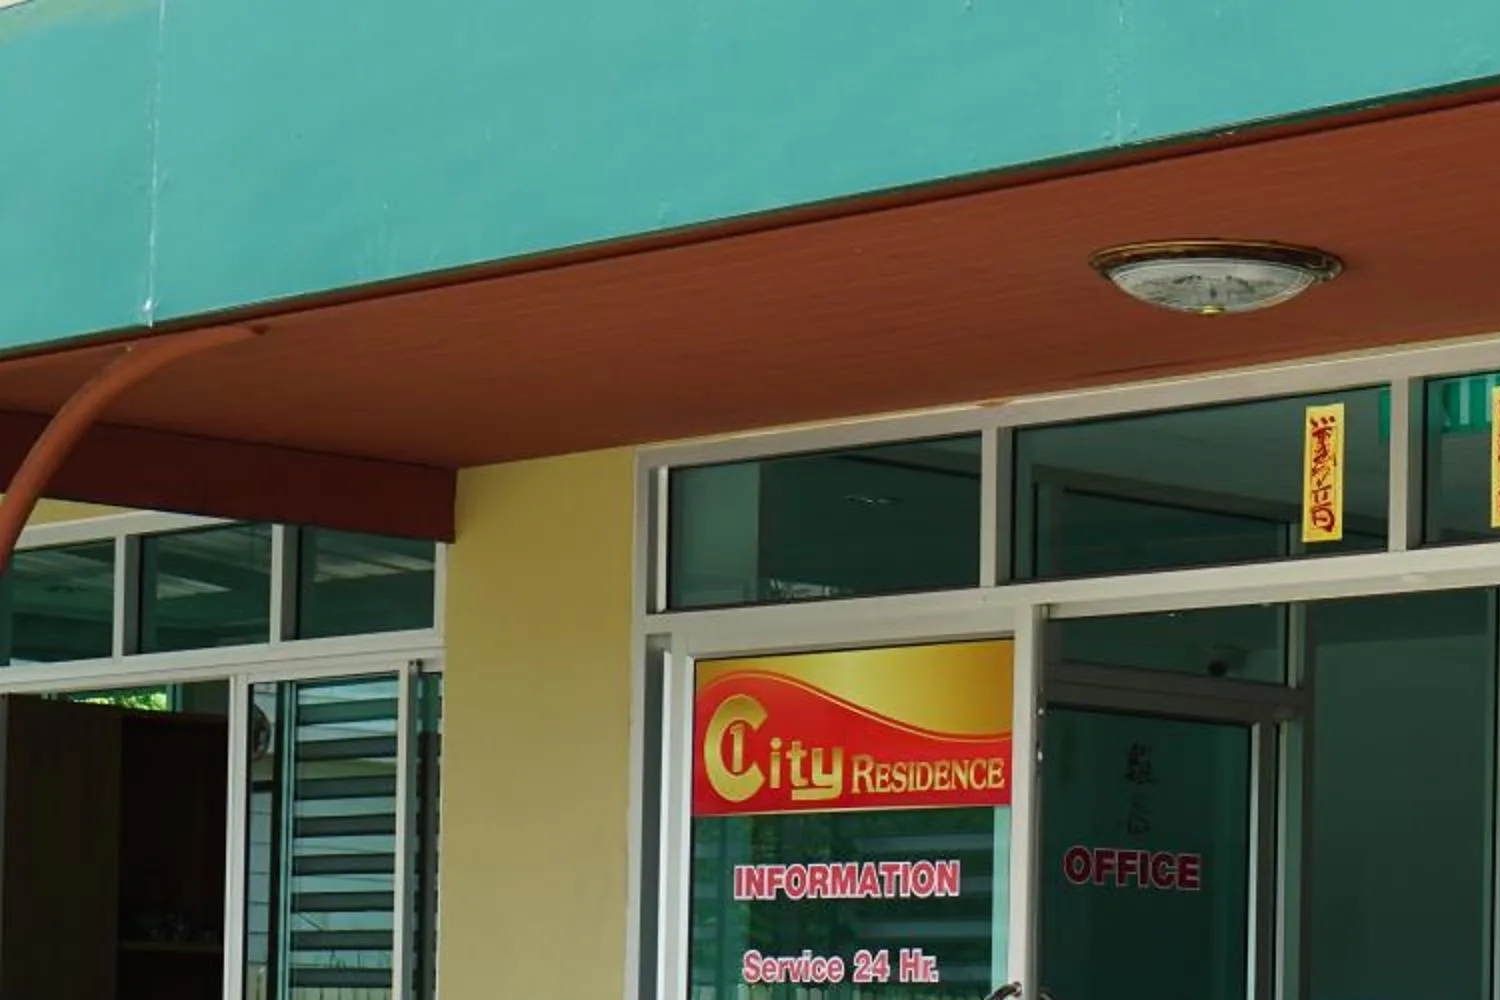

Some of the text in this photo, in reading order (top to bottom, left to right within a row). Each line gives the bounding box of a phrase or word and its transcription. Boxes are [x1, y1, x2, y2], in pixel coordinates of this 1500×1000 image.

[852, 754, 1005, 794] RESIDENCE
[734, 860, 960, 900] INFORMATION
[1063, 845, 1201, 890] OFFICE
[742, 948, 940, 984] Service 24 Hr.
